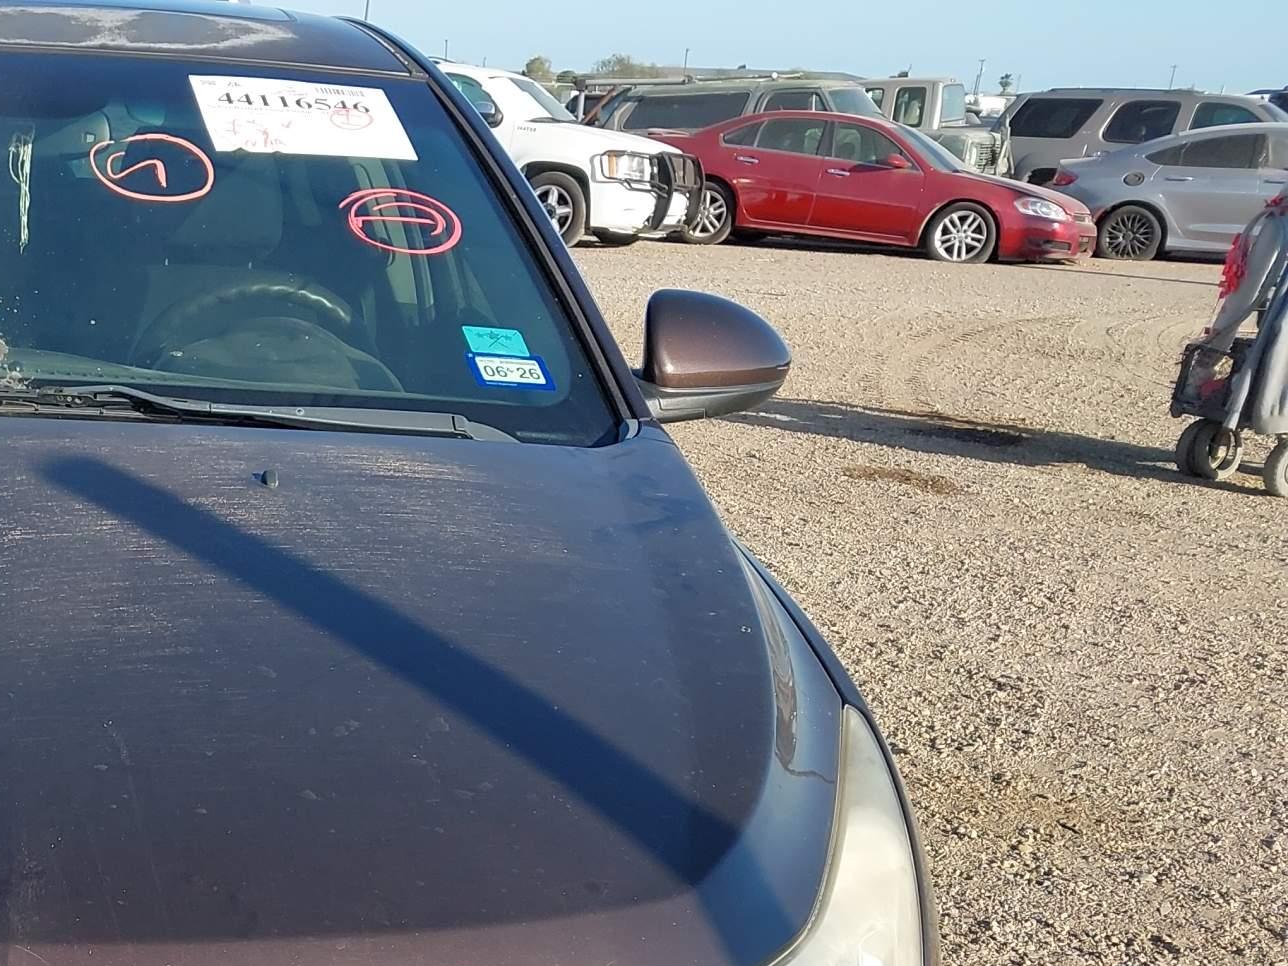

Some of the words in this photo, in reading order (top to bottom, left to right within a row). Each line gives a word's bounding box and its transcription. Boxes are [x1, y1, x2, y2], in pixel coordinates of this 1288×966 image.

[218, 92, 370, 114] 44116546
[483, 365, 508, 378] 06
[516, 367, 541, 380] 26
